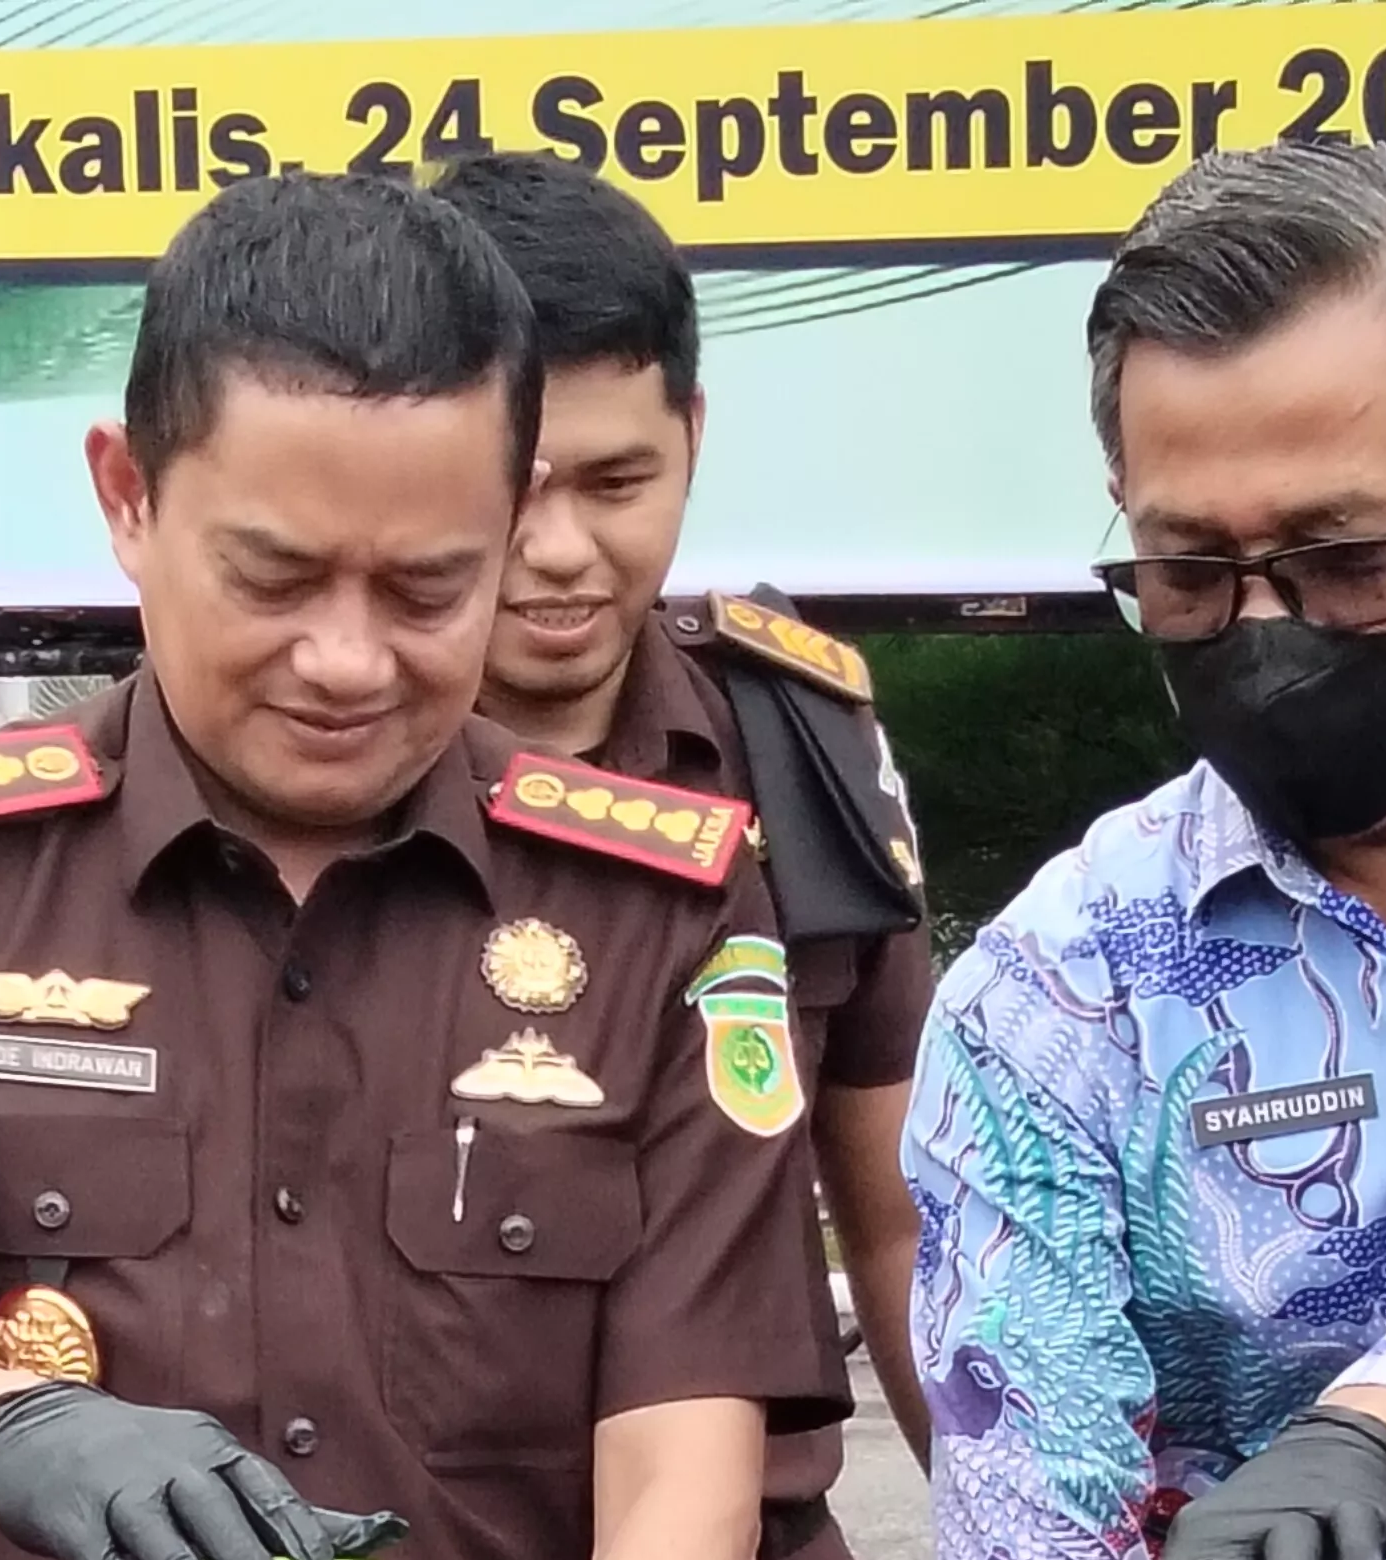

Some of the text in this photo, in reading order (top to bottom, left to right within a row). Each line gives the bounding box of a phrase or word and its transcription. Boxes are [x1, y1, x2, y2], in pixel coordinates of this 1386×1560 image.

[345, 77, 494, 175] 24
[532, 59, 1238, 203] September
[31, 1049, 143, 1078] INDRAWAN
[1204, 1085, 1366, 1132] SYAHRUDDIN
